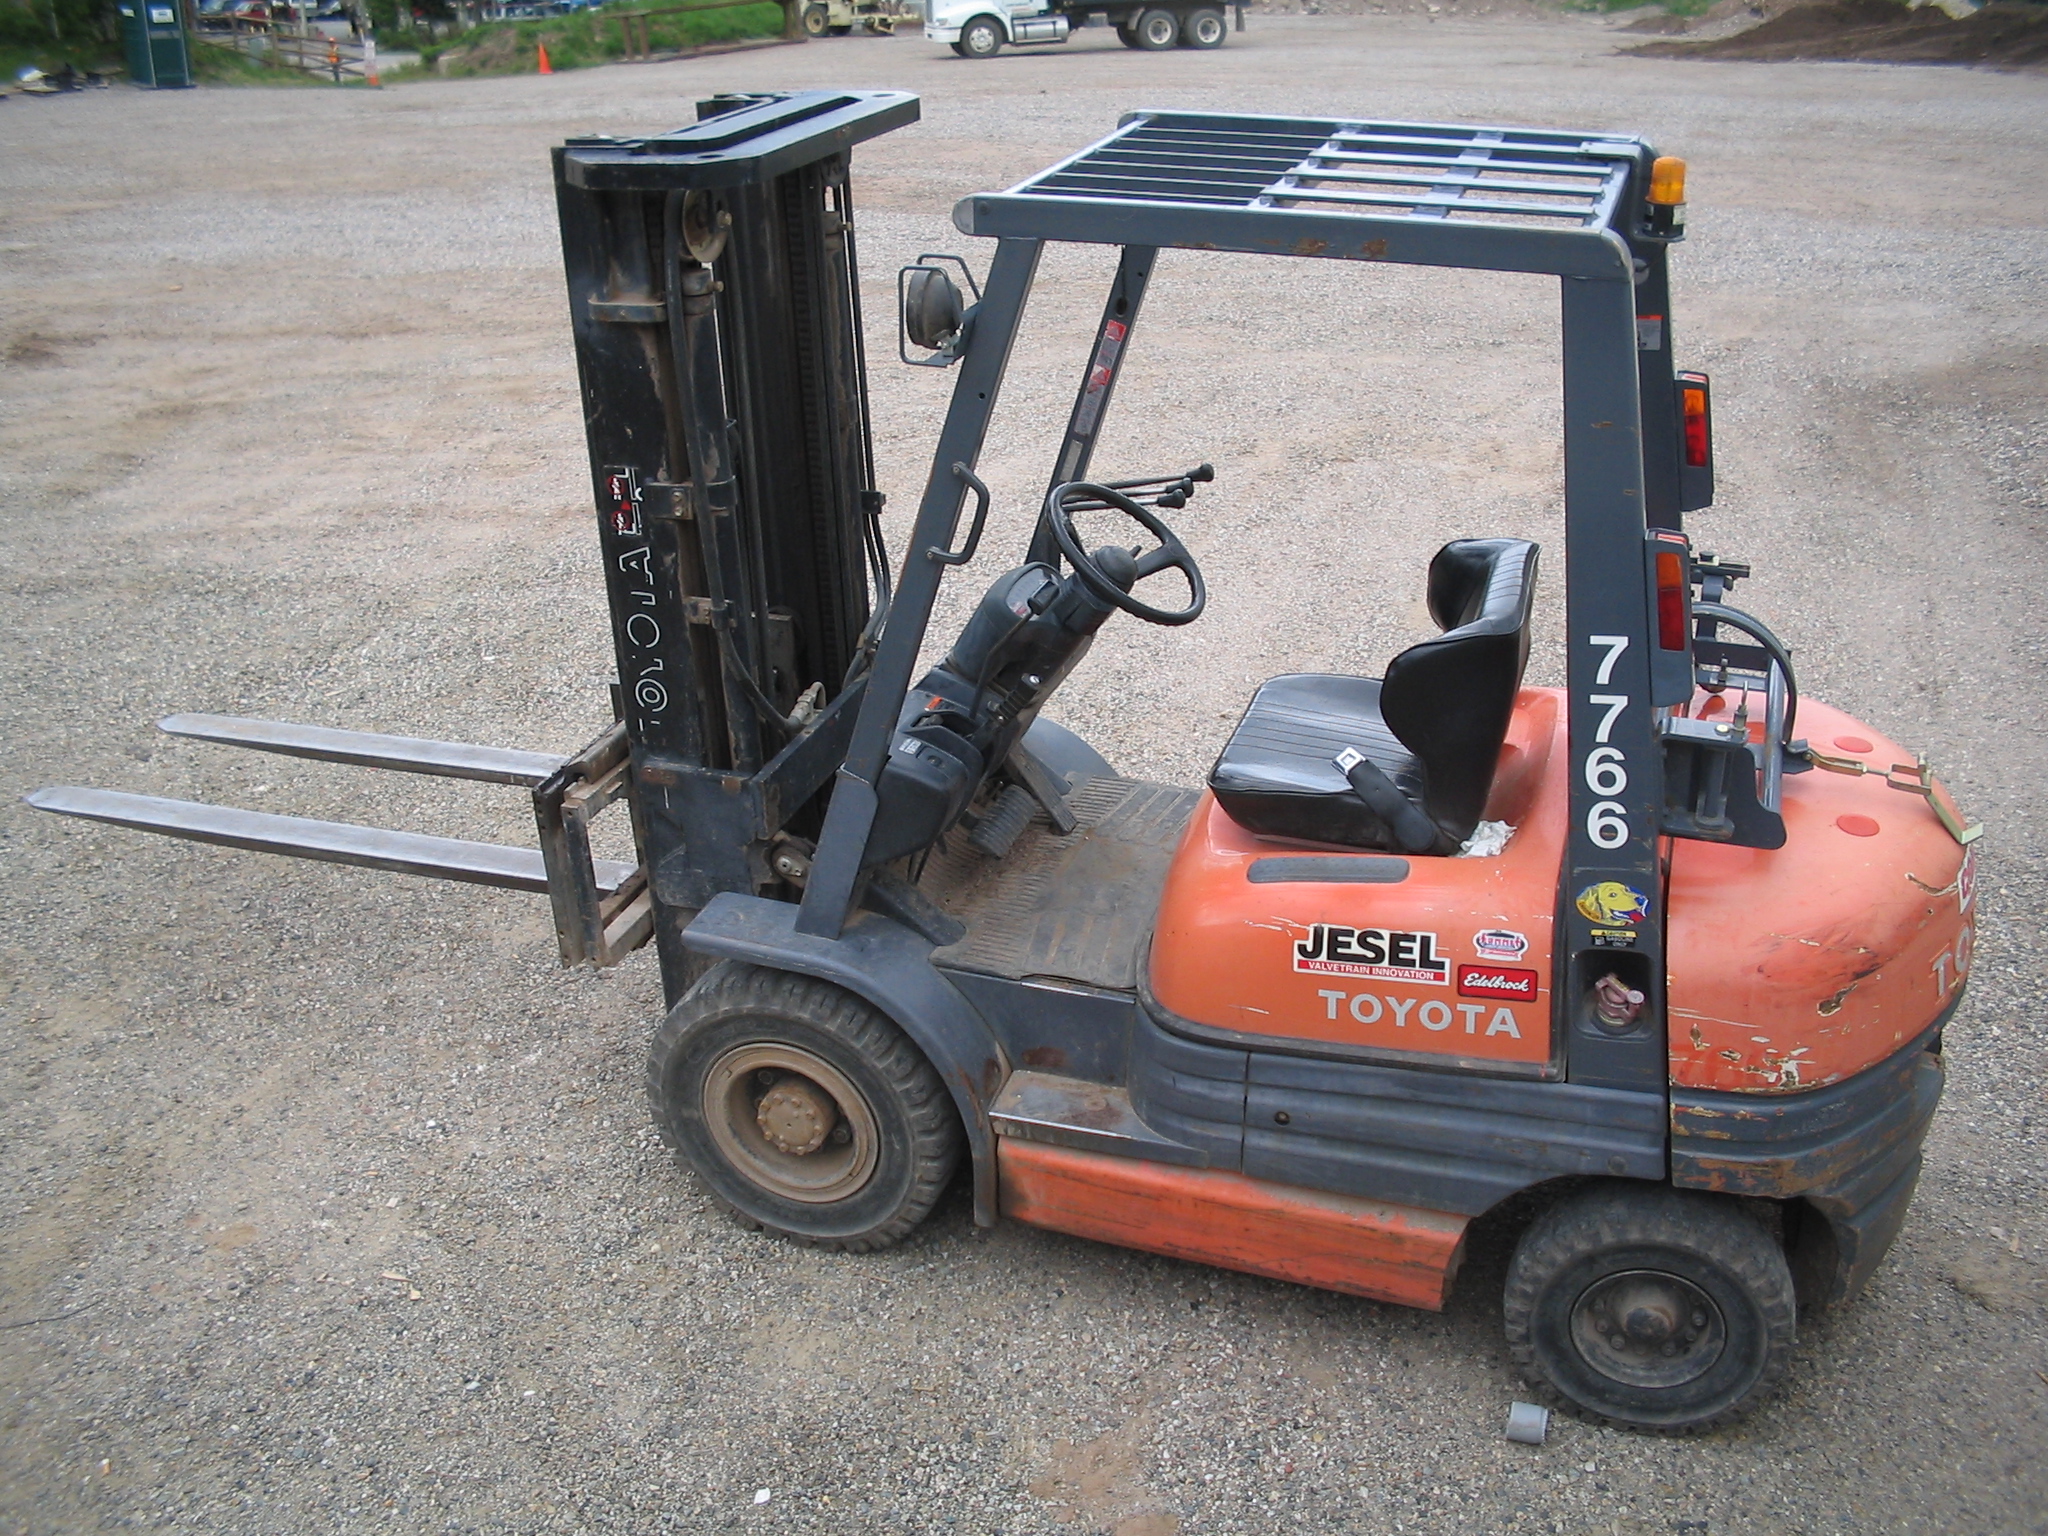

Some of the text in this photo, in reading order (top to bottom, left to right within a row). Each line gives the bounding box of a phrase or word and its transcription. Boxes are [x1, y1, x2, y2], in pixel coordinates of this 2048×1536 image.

[1584, 634, 1630, 850] 7766
[1297, 926, 1446, 971] JESEL
[1307, 961, 1435, 981] VALVETRAIN INNOVATION
[1463, 971, 1529, 992] Edelbrock
[1317, 989, 1522, 1039] TOYOTA
